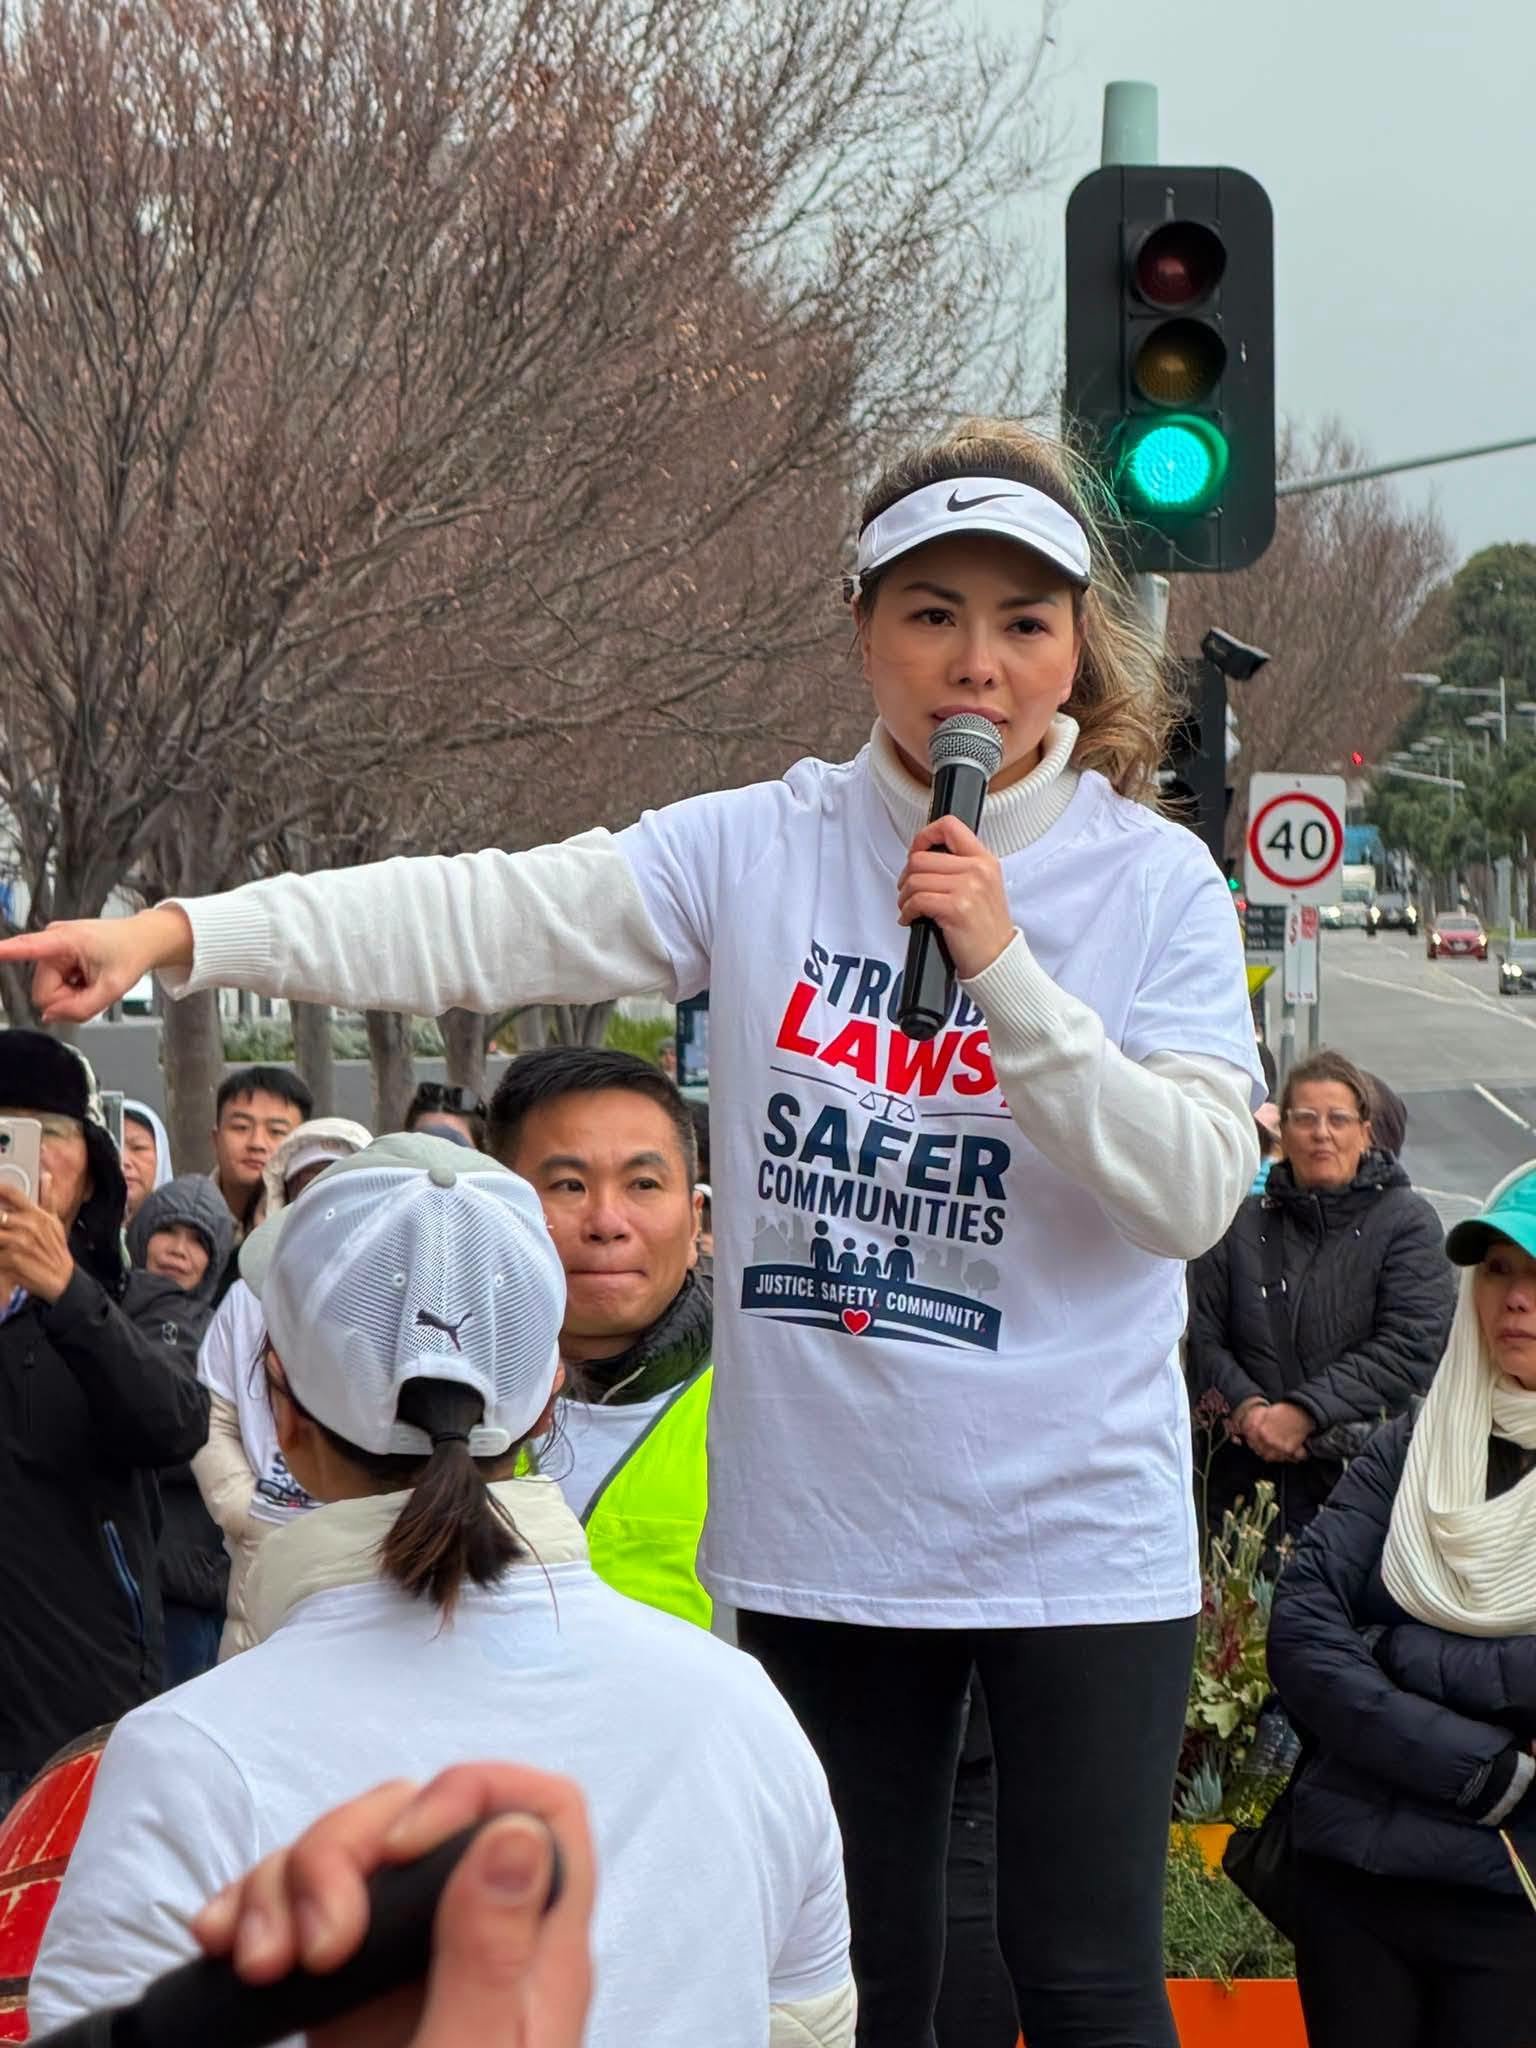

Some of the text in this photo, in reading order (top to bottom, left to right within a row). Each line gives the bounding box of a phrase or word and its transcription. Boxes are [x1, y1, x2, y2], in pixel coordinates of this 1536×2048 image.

[1267, 820, 1327, 860] 40
[763, 1092, 1011, 1200] SAFER
[758, 1160, 1007, 1246] COMMUNITIES
